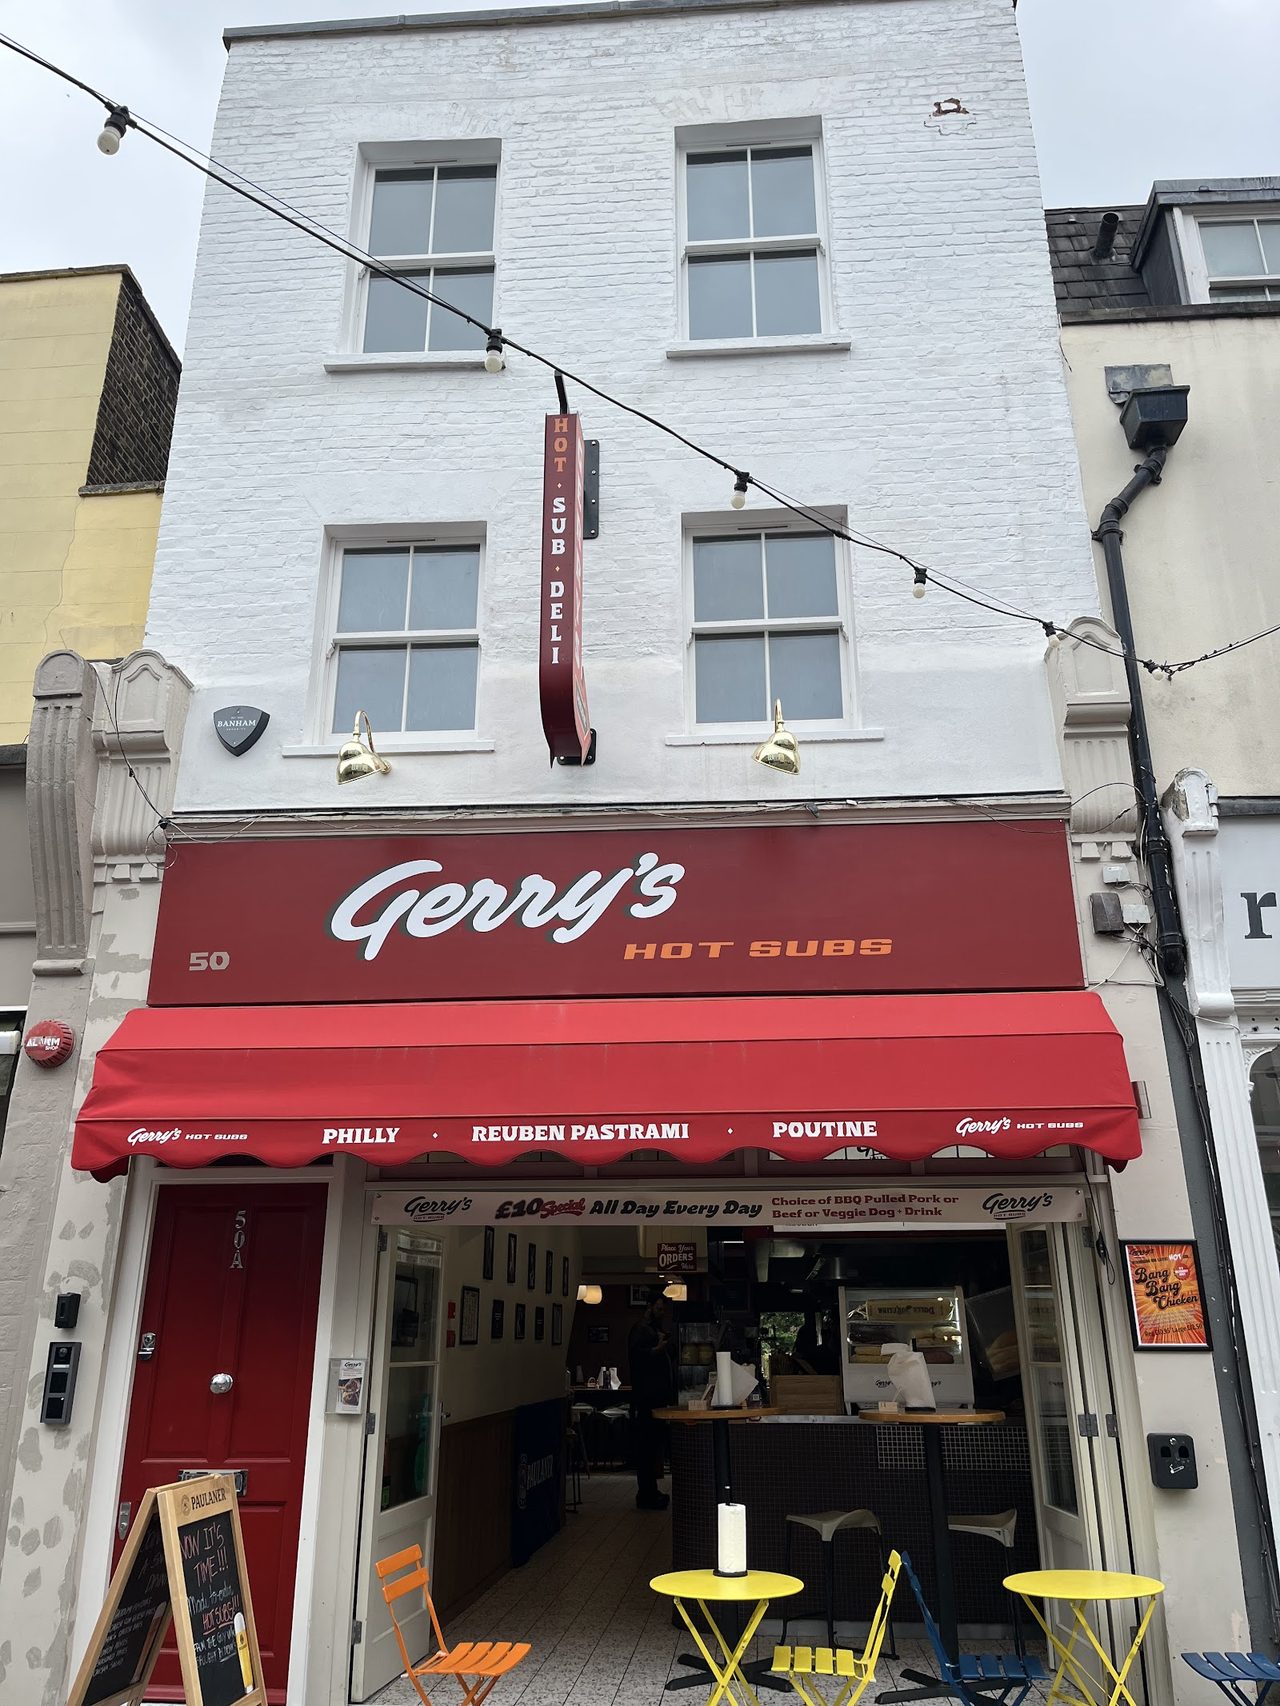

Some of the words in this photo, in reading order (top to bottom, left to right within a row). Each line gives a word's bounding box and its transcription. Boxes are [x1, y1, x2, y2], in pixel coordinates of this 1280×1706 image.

[554, 418, 569, 472] HOT
[551, 497, 567, 555] SUB
[549, 581, 565, 664] DELI
[217, 719, 256, 727] BANHAM
[330, 852, 686, 961] Gerry's
[623, 942, 735, 960] HOT
[749, 938, 893, 957] SUBS
[189, 951, 230, 971] 50
[127, 1127, 182, 1146] Gerry's
[322, 1127, 400, 1144] PHILLY
[472, 1124, 565, 1142] REUBEN
[570, 1123, 690, 1141] PASTRAMI
[772, 1121, 878, 1138] POUTINE
[955, 1116, 1012, 1137] Gerry's
[404, 1196, 472, 1217] Gerry's
[494, 1197, 544, 1219] £10
[540, 1197, 586, 1219] Special
[589, 1200, 619, 1214] All
[620, 1200, 660, 1218] Day
[663, 1200, 719, 1218] Every
[722, 1200, 763, 1218] Day
[771, 1197, 816, 1206] Choice
[818, 1196, 832, 1205] of
[834, 1195, 862, 1205] BBQ
[864, 1194, 906, 1203] Pulled
[908, 1194, 941, 1203] Pork
[982, 1192, 1053, 1214] Gerry's
[772, 1209, 802, 1218] Beef
[822, 1208, 867, 1219] Veggie
[869, 1207, 896, 1218] Dog
[904, 1207, 942, 1216] Drink
[230, 1210, 246, 1269] 50A
[658, 1252, 694, 1267] ORDERS
[1134, 1267, 1169, 1284] Bang
[1145, 1280, 1180, 1297] Bang
[1153, 1295, 1198, 1310] Chicken
[191, 1488, 227, 1510] PAULANER
[203, 1521, 224, 1550] IT'S
[202, 1609, 215, 1630] HOT
